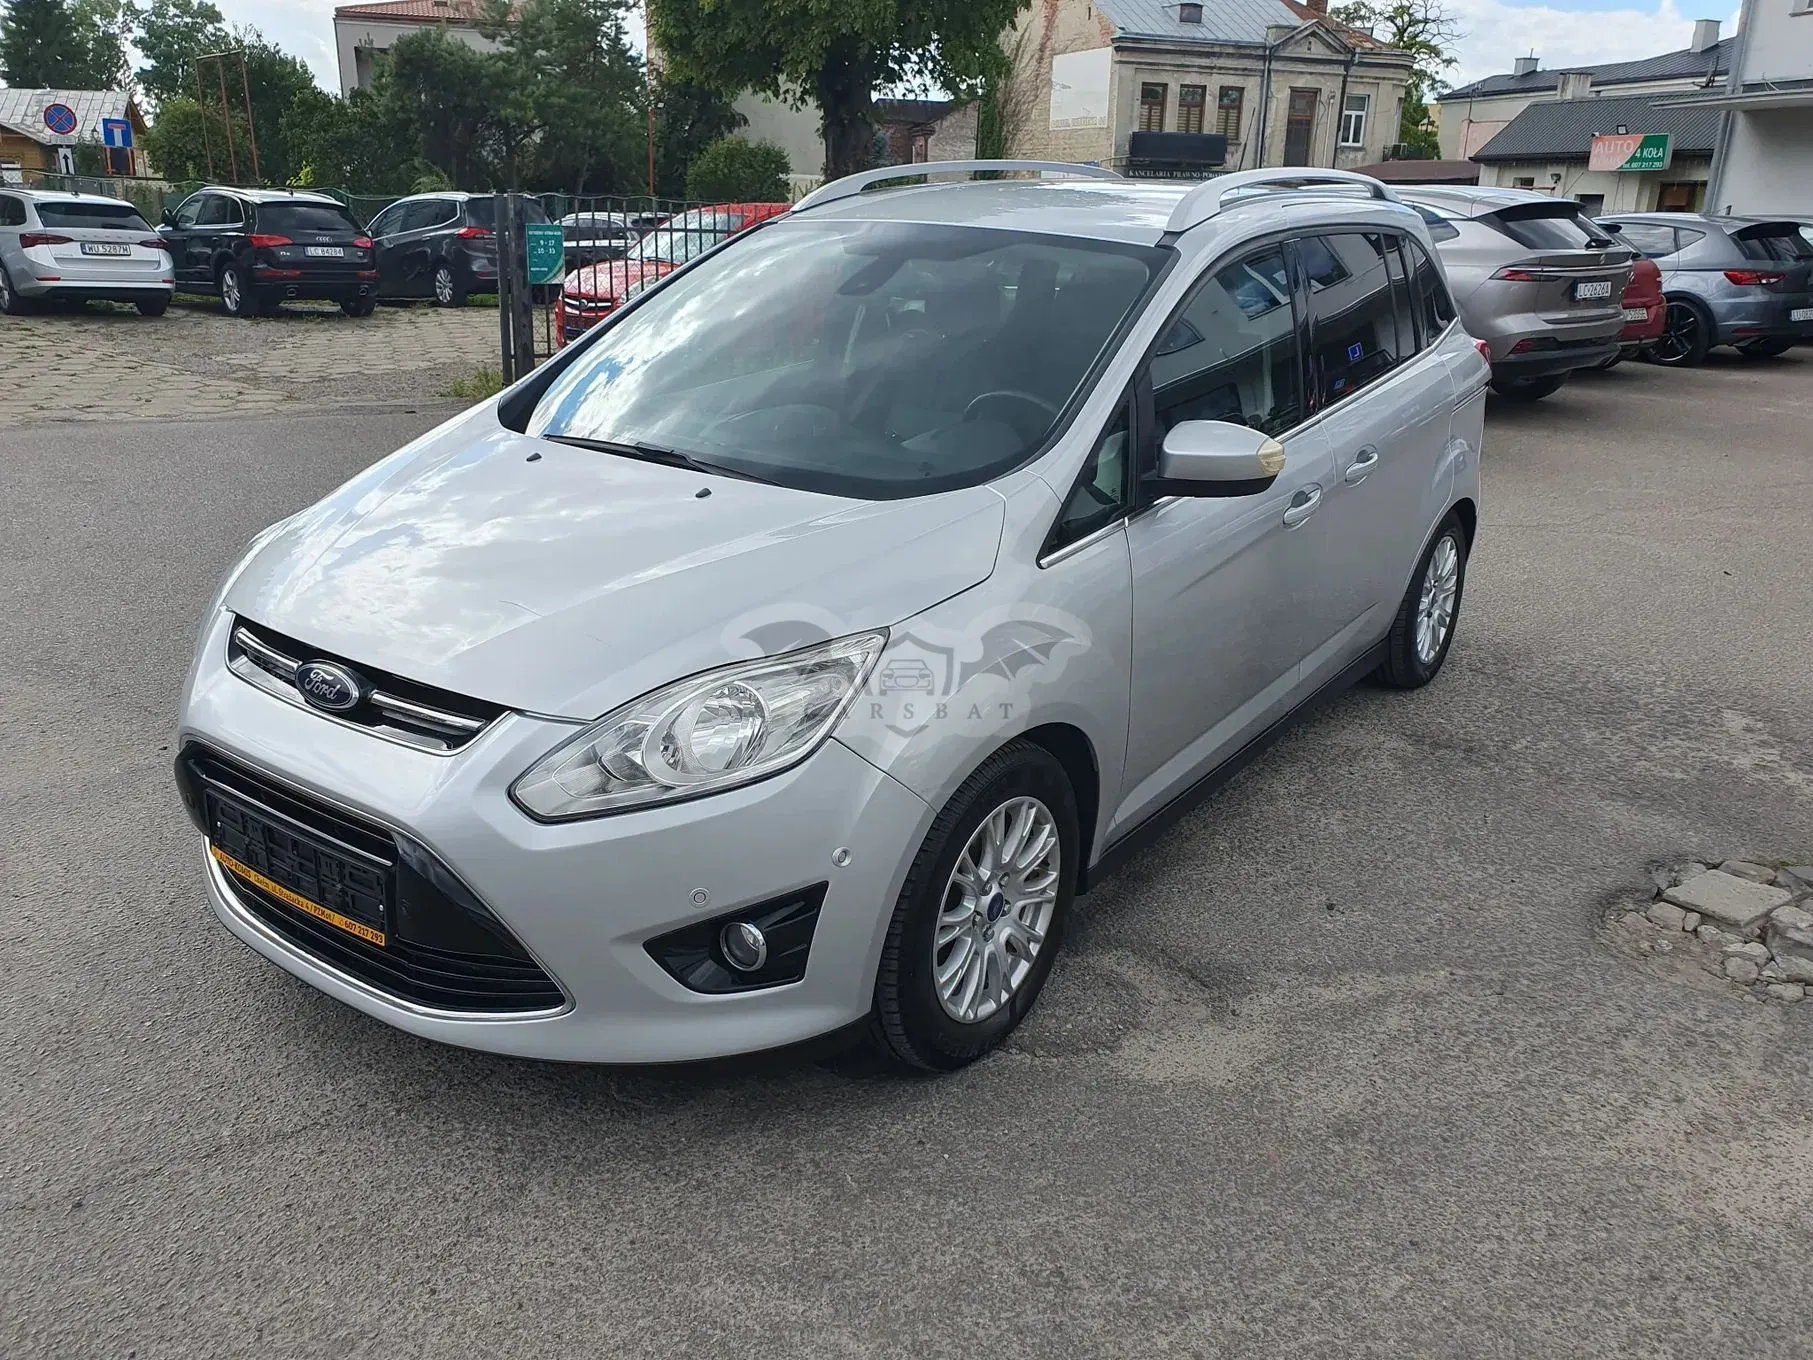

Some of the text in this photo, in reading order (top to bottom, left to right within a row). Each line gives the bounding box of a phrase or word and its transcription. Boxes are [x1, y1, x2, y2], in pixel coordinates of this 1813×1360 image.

[1594, 141, 1633, 153] AUTO
[1635, 147, 1663, 158] 4 KOŁA
[1128, 170, 1170, 179] KANCELARIA
[88, 244, 99, 253] WU
[304, 668, 342, 700] Ford
[344, 919, 357, 933] 607
[358, 925, 370, 938] 217
[371, 931, 384, 944] 293
